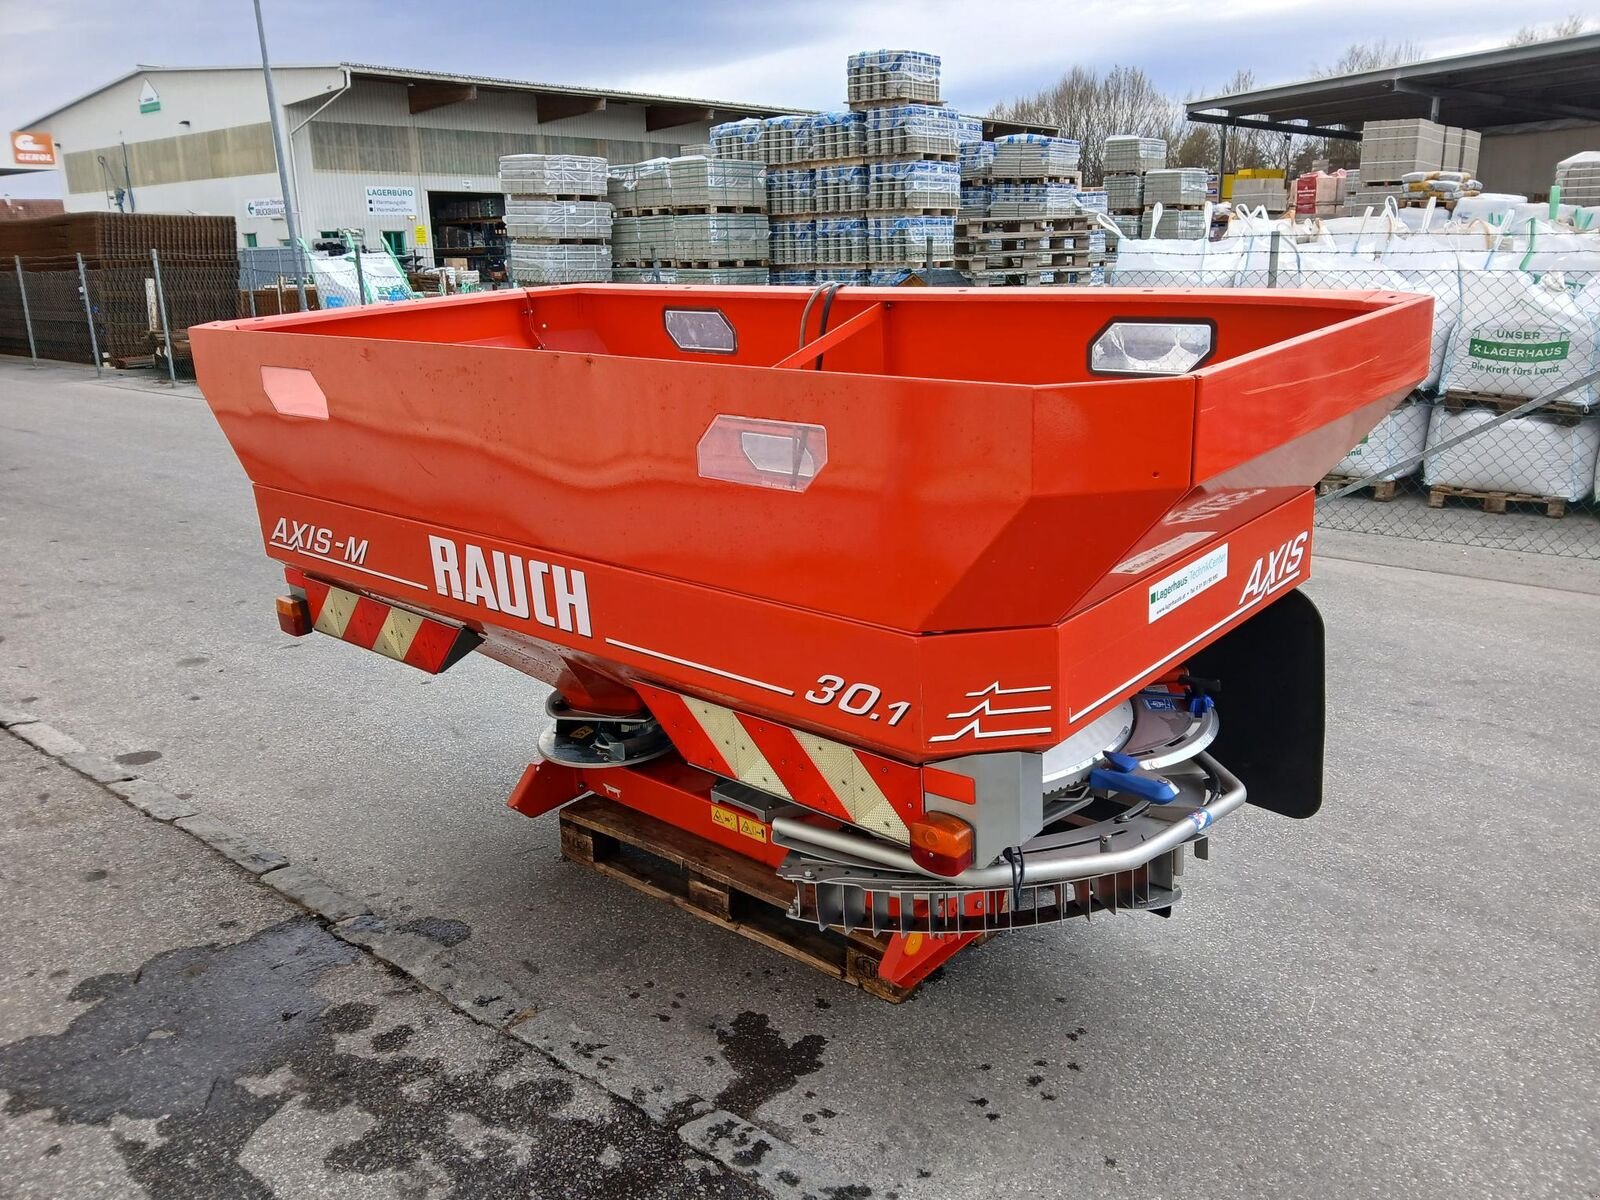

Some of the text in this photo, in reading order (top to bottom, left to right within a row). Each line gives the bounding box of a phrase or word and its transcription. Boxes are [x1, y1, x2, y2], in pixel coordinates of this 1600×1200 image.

[367, 188, 414, 197] LAGERBÜRO
[1496, 329, 1541, 340] UNSER
[1483, 346, 1562, 358] LAGERHAUS
[1471, 361, 1560, 376] Die Kraft fürs Land
[271, 517, 369, 565] AXIS-M
[1238, 531, 1308, 606] AXIS
[428, 534, 593, 638] RAUCH
[1156, 576, 1188, 601] Lagerhaus
[804, 674, 912, 726] 30.1
